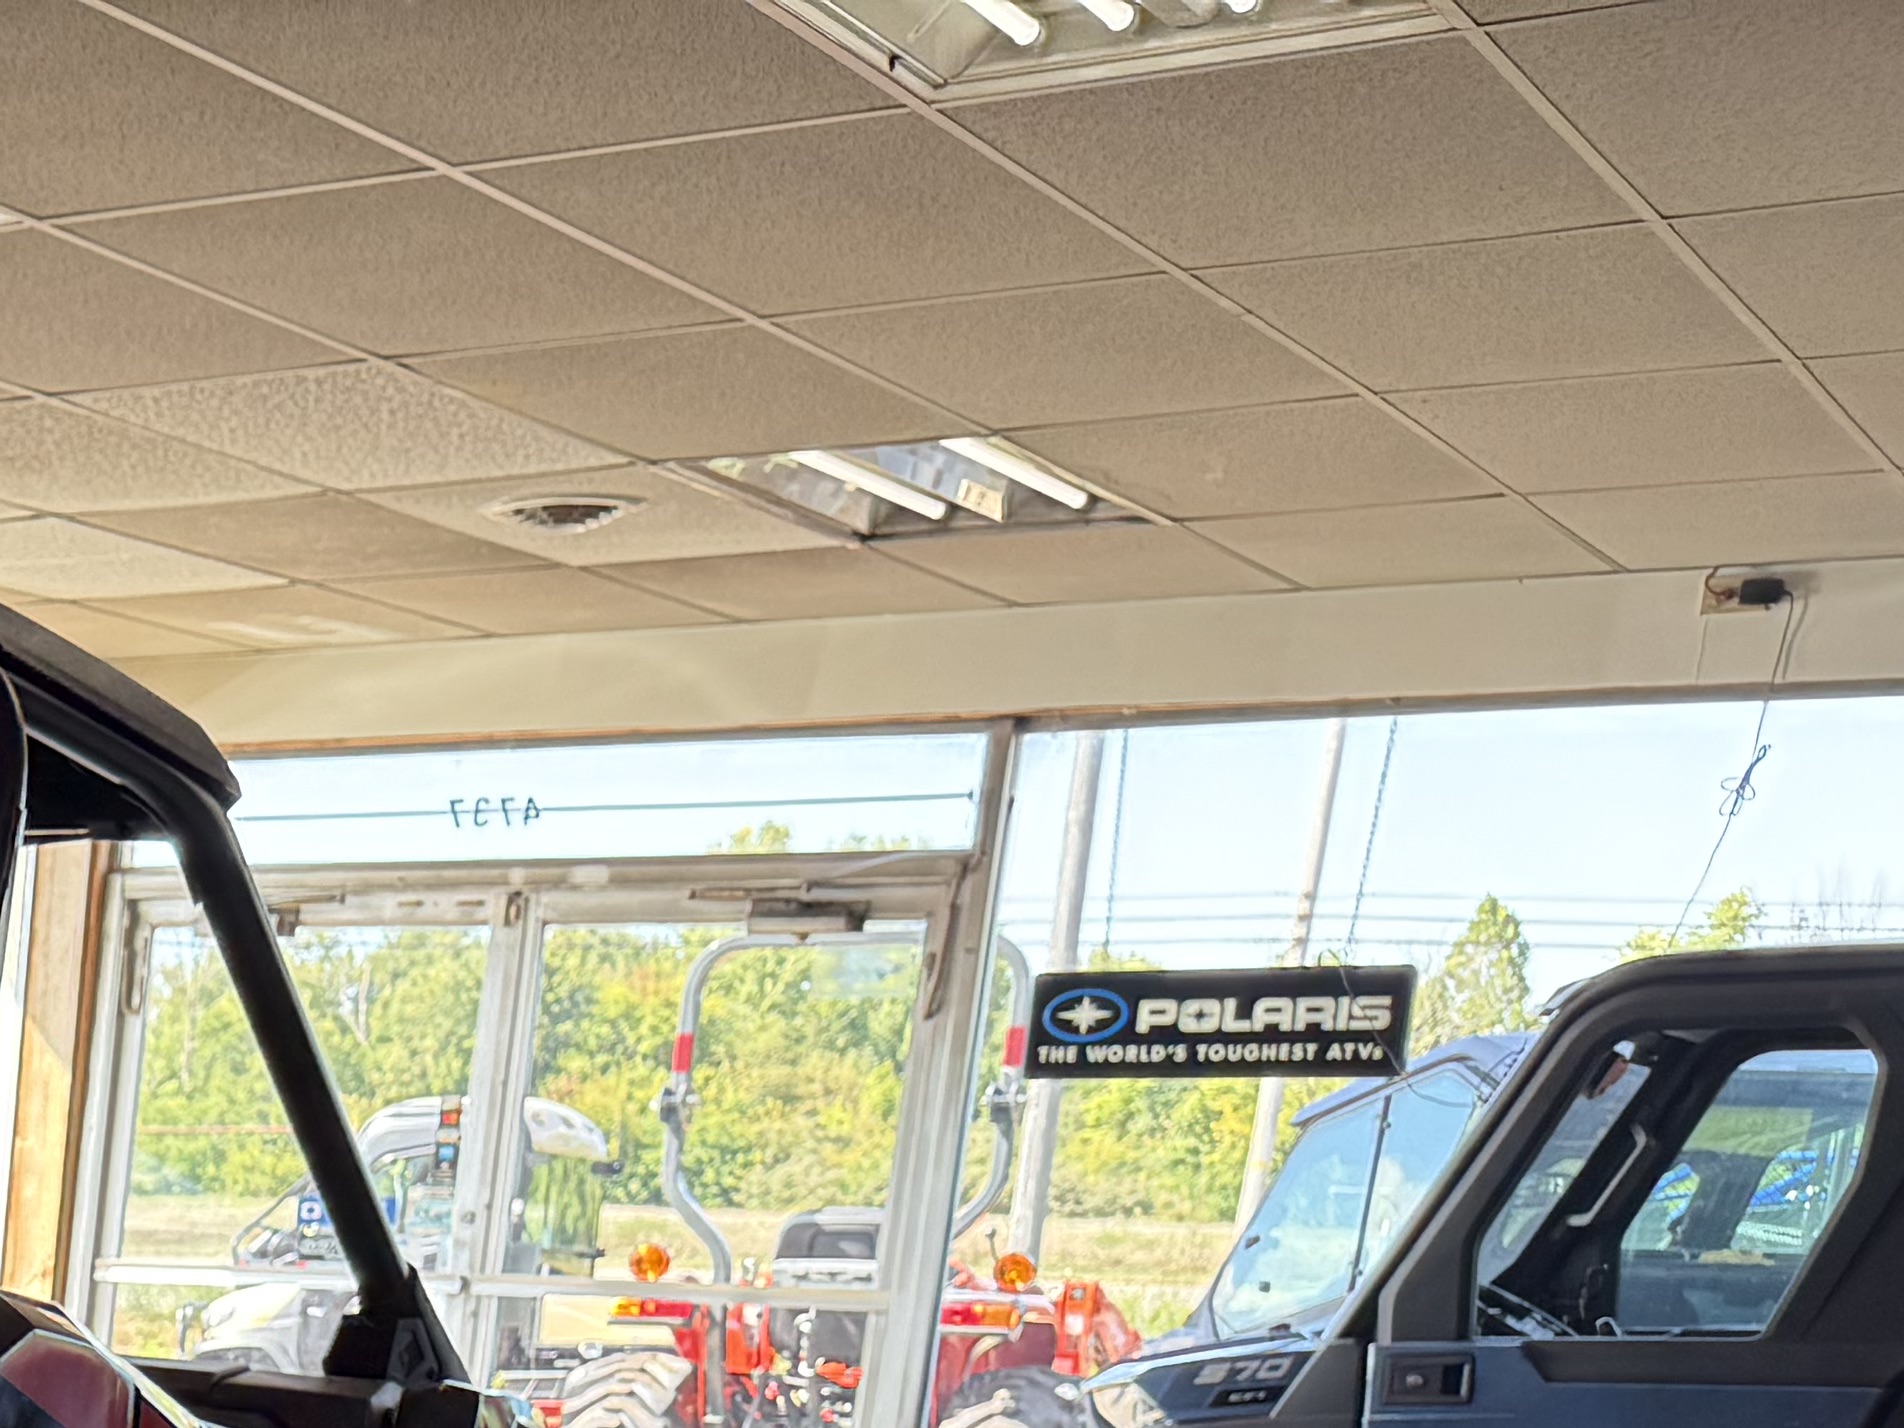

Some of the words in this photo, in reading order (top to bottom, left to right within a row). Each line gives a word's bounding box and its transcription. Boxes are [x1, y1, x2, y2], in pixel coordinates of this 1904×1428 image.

[1134, 995, 1392, 1034] POLARIS
[1038, 1045, 1077, 1064] THE
[1086, 1043, 1189, 1064] WORLD'S
[1196, 1042, 1318, 1063] TOUGHEST
